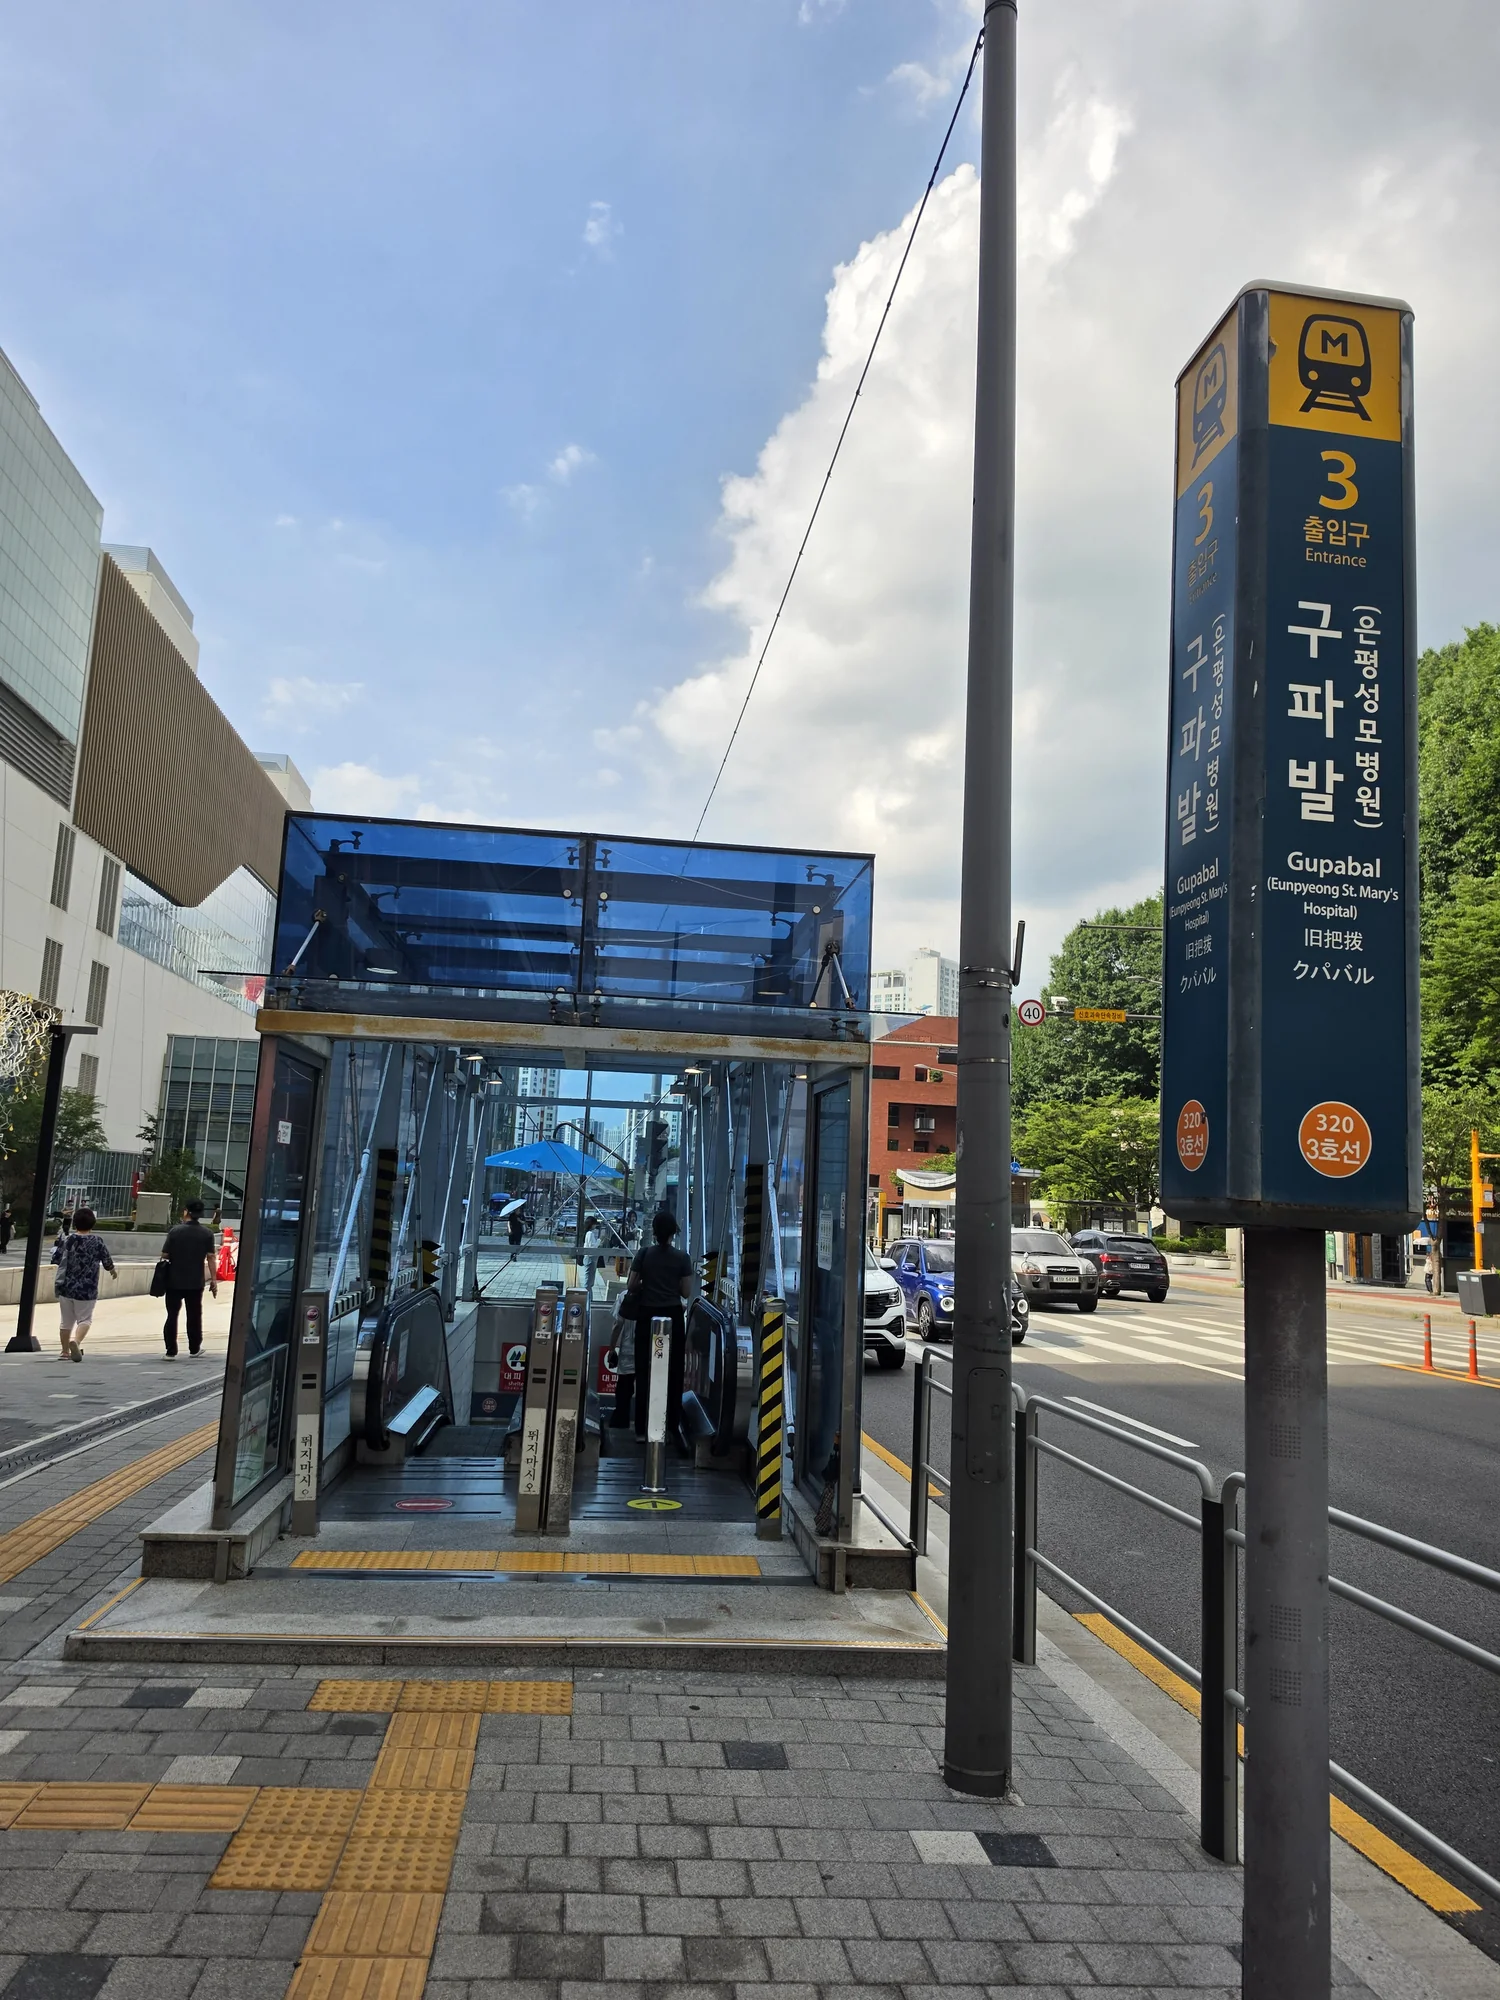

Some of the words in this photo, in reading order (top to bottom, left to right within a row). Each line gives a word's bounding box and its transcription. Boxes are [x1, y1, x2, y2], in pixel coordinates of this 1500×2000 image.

[1321, 329, 1348, 357] M
[1319, 450, 1359, 510] 3
[1195, 481, 1213, 546] 3
[1303, 515, 1370, 548] 출입구
[1188, 538, 1218, 588] 출입구
[1305, 547, 1367, 567] Entrance
[1287, 600, 1344, 823] 구파발
[1352, 604, 1384, 829] (은평성모병원)
[1177, 634, 1208, 846] 구파발
[1176, 857, 1219, 895] Gupabal
[1287, 851, 1381, 878] Gupabal
[1169, 898, 1201, 920] (Eunpyeong
[1208, 881, 1228, 901] Mary's
[1267, 876, 1339, 899] (Eunpyeong
[1341, 883, 1357, 898] St.
[1359, 885, 1399, 903] Mary's
[1184, 910, 1210, 931] Hospital)
[1303, 901, 1358, 920] Hospital)
[1180, 966, 1217, 994] クパバル
[1293, 960, 1375, 986] クパバル
[1024, 1007, 1040, 1020] 40
[1183, 1111, 1200, 1130] 320
[1316, 1114, 1355, 1134] 320
[1180, 1134, 1204, 1157] 3호선
[1306, 1138, 1361, 1164] 3호선
[299, 1434, 314, 1499] 뛰지마시오
[524, 1428, 539, 1493] 뛰지마시오
